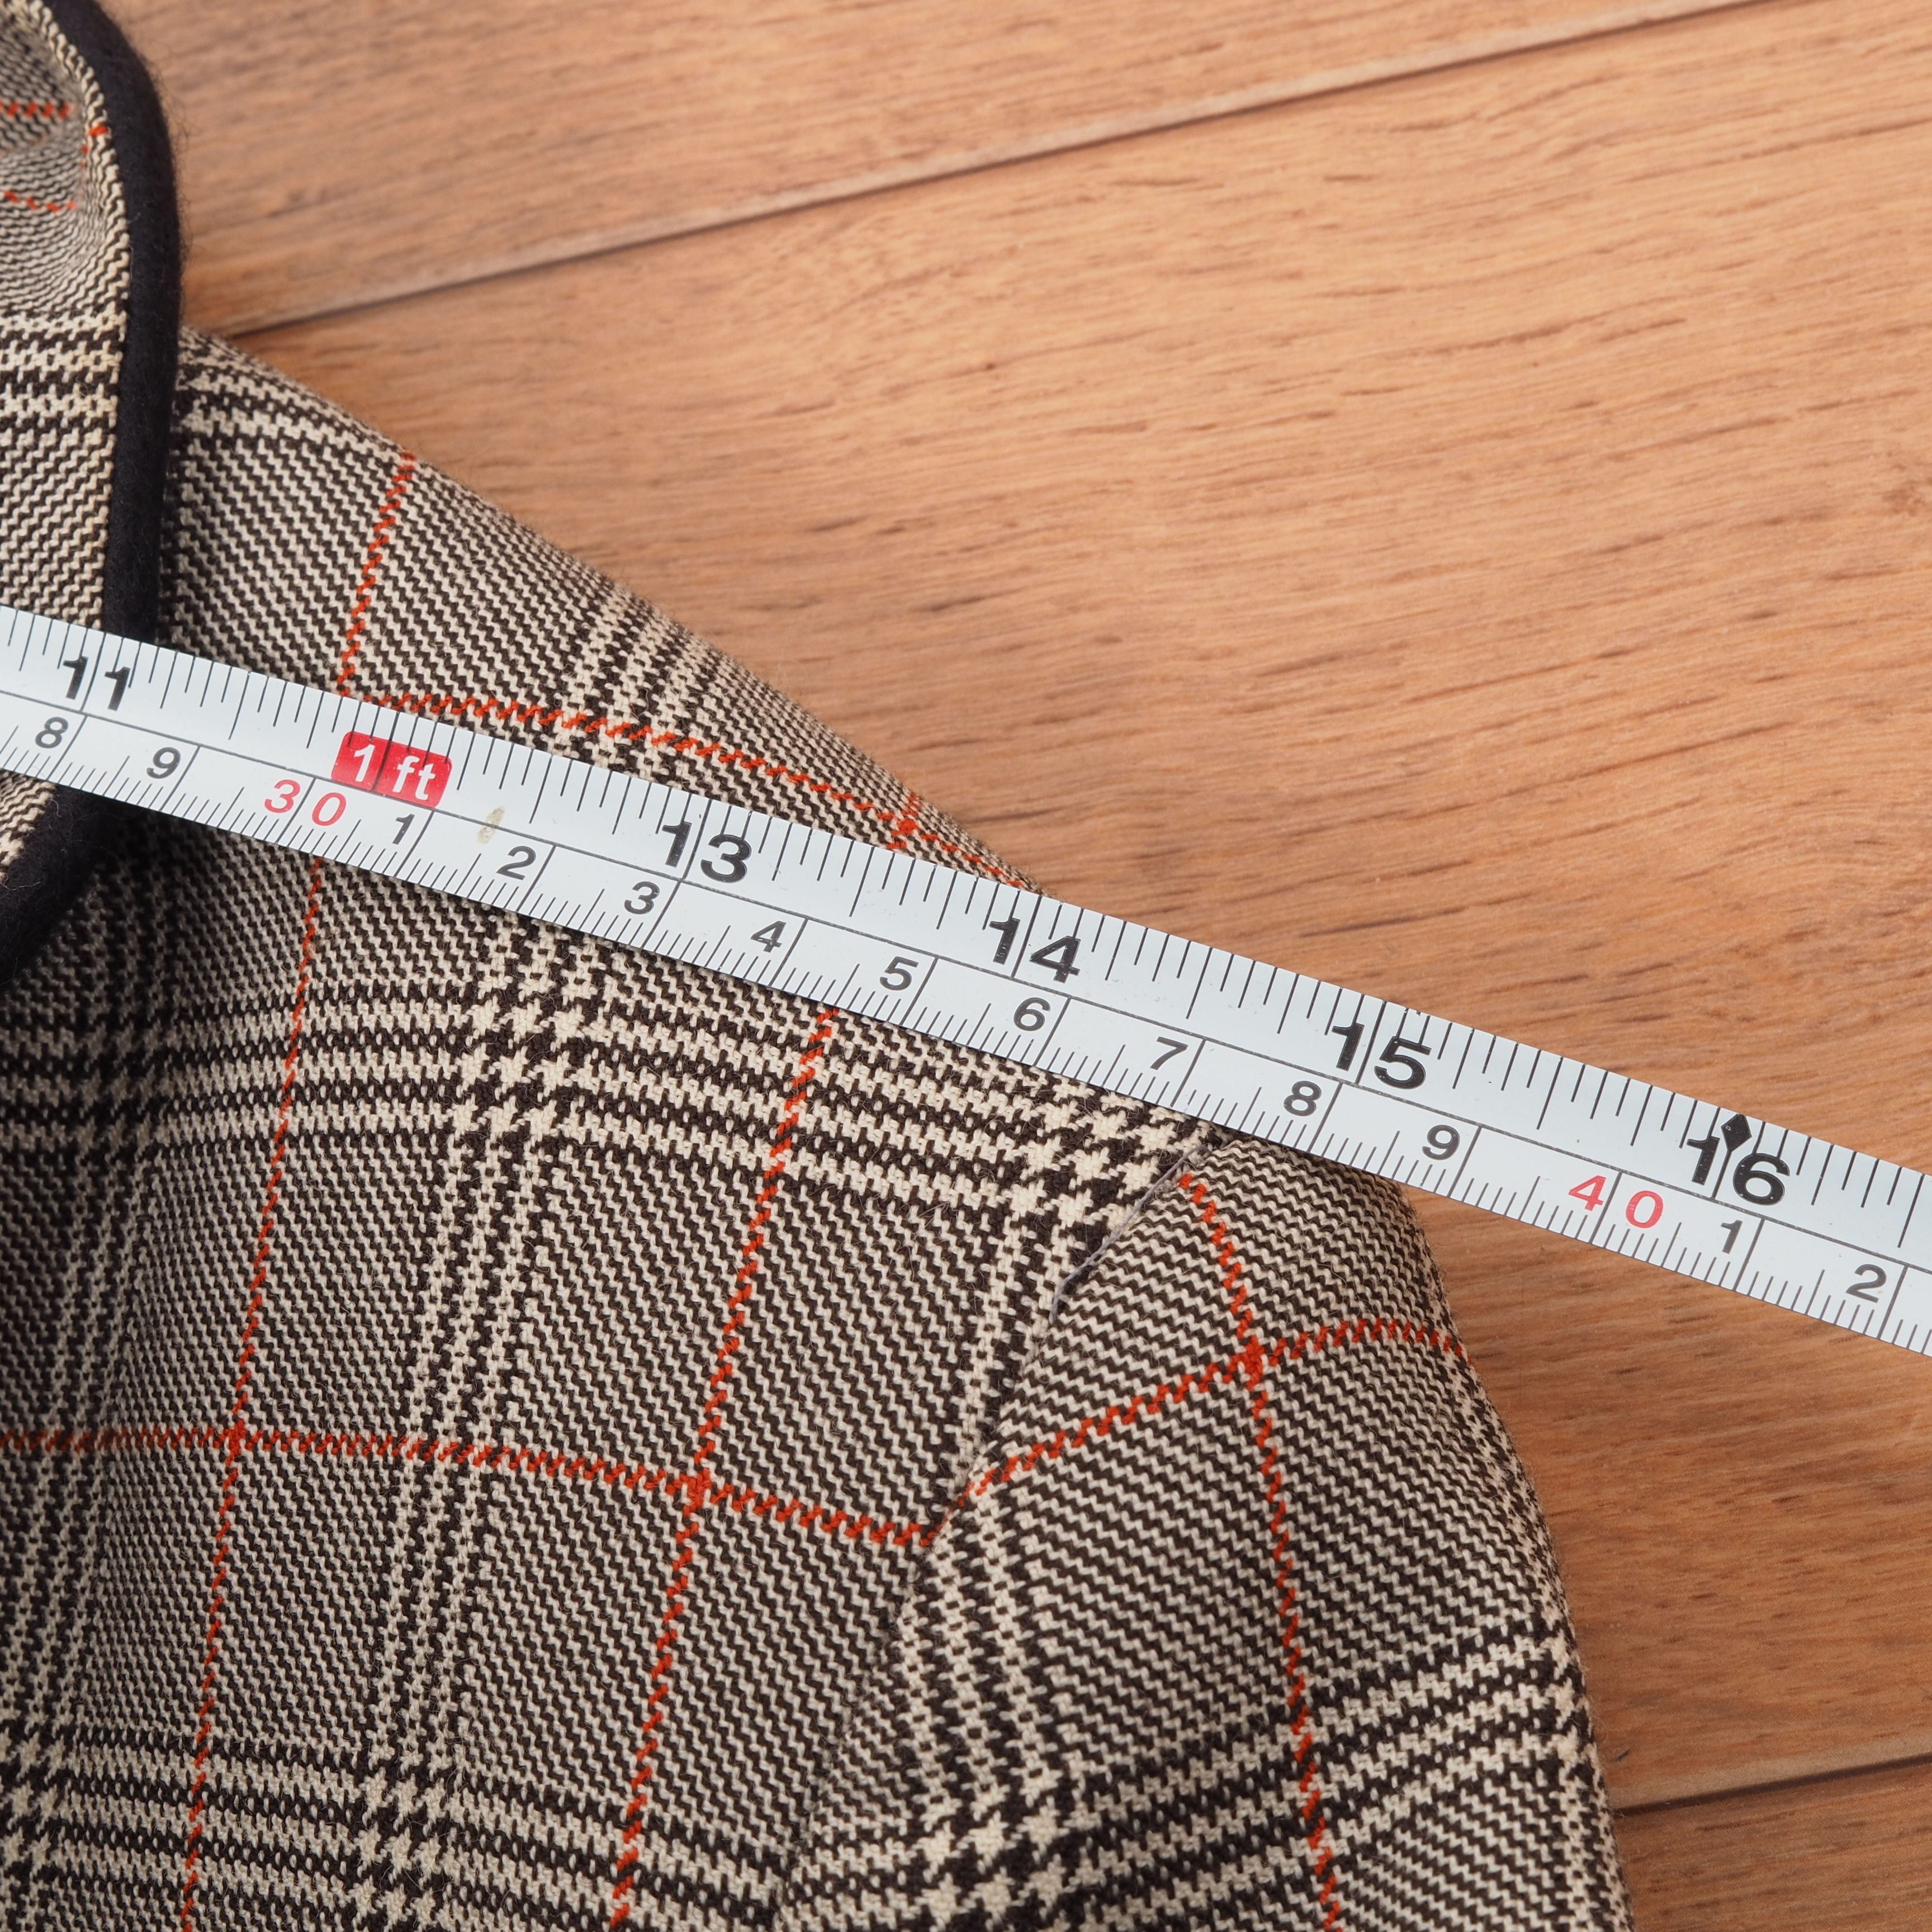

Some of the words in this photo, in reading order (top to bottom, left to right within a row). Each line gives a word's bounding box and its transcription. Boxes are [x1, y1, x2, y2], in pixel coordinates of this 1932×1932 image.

[64, 656, 132, 711] 11
[35, 717, 69, 749] 8
[146, 747, 181, 779] 9
[352, 744, 376, 783] 1
[395, 756, 436, 800] ft
[264, 779, 347, 827] 30
[394, 813, 415, 845] 1
[497, 845, 537, 880] 2
[662, 820, 752, 883] 13
[624, 880, 660, 915] 3
[751, 920, 787, 953] 4
[988, 917, 1082, 983] 14
[879, 956, 919, 991] 5
[1012, 997, 1052, 1031] 6
[1149, 1036, 1189, 1071] 7
[1331, 1022, 1432, 1089] 15
[1284, 1081, 1322, 1117] 8
[1421, 1124, 1461, 1160] 9
[1687, 1135, 1791, 1205] 16
[1568, 1174, 1664, 1229] 40
[1721, 1219, 1744, 1254] 1
[1847, 1263, 1888, 1303] 2
